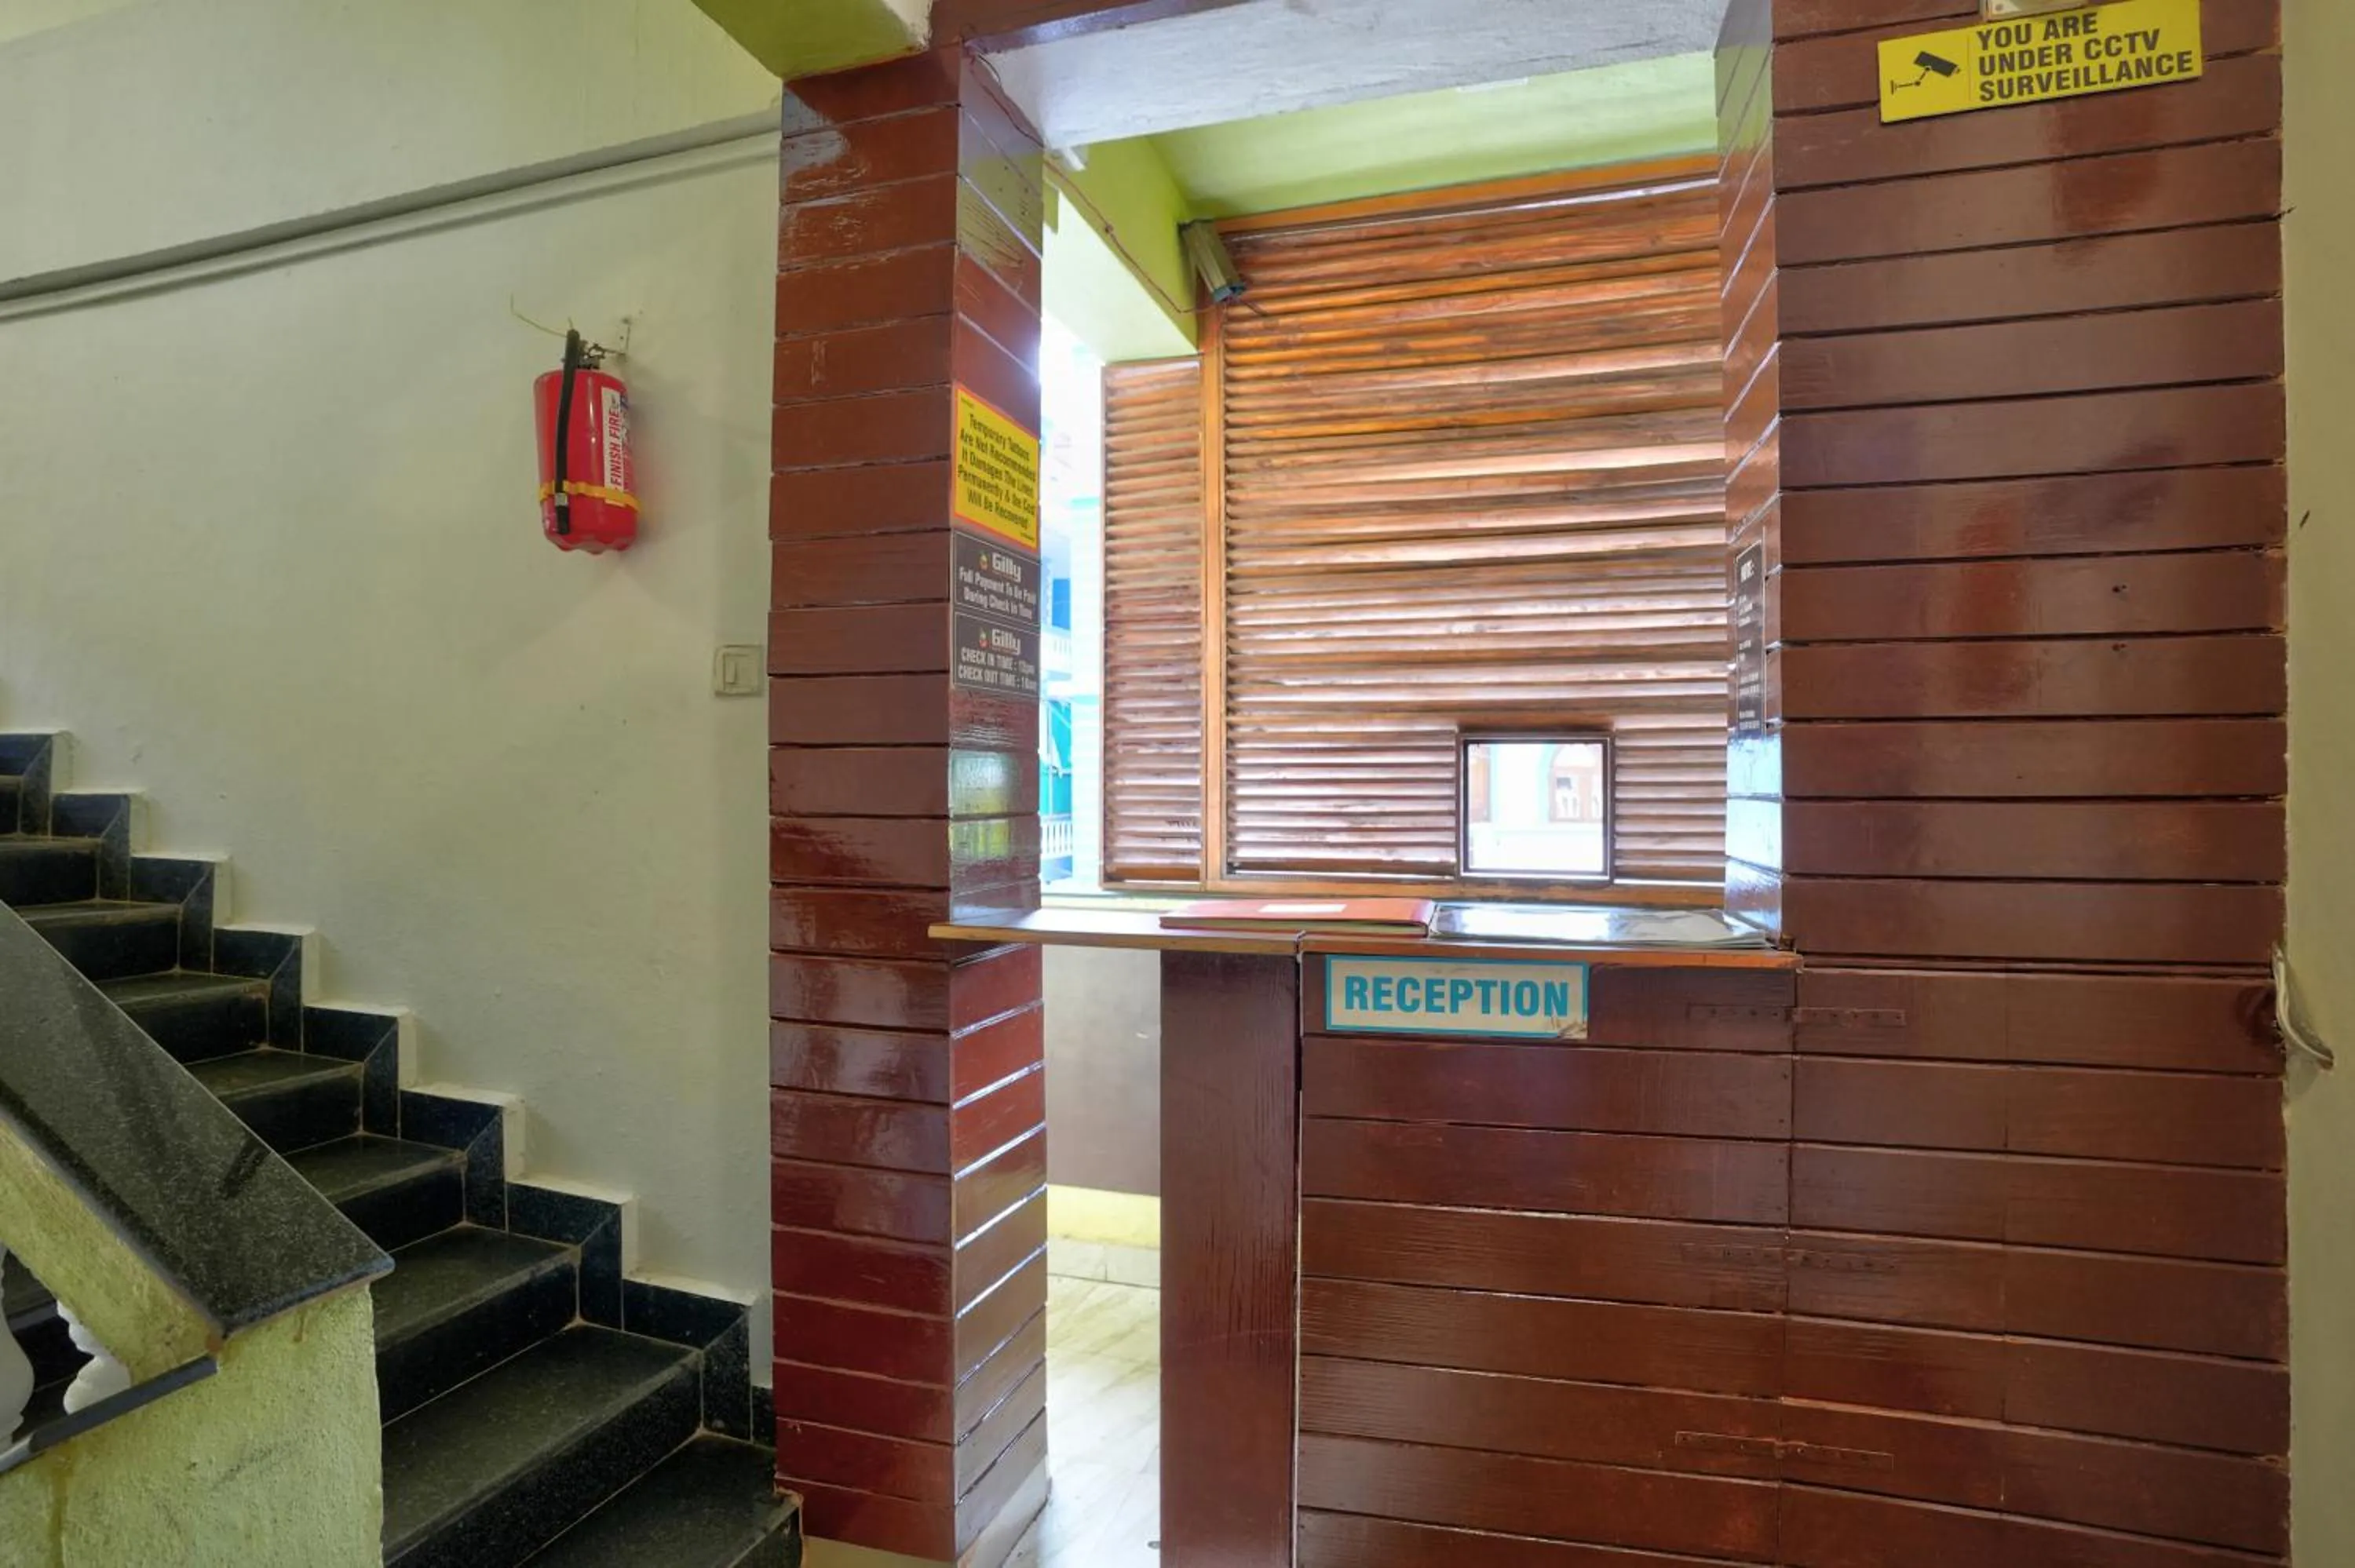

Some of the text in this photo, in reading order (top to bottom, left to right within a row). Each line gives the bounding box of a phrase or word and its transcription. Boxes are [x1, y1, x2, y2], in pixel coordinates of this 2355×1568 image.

[1977, 13, 2098, 51] YOU ARE
[1978, 28, 2160, 75] UNDER CCTV
[1979, 50, 2193, 101] SURVEILLANCE
[960, 428, 973, 446] Are
[975, 437, 988, 454] Not
[969, 414, 1006, 449] Temporary
[608, 410, 623, 486] FINISH FIRE
[969, 451, 1002, 480] Damages
[967, 488, 982, 507] Will
[958, 567, 974, 583] Full
[974, 571, 1004, 593] Payment
[991, 552, 1021, 582] Gilly
[963, 587, 988, 608] During
[988, 593, 1010, 611] Check
[991, 629, 1021, 656] Gilly
[961, 647, 986, 664] CHECK
[987, 652, 995, 666] IN
[997, 655, 1013, 670] TIME
[958, 665, 983, 681] CHECK
[984, 669, 998, 684] OUT
[1344, 976, 1569, 1017] RECEPTION
